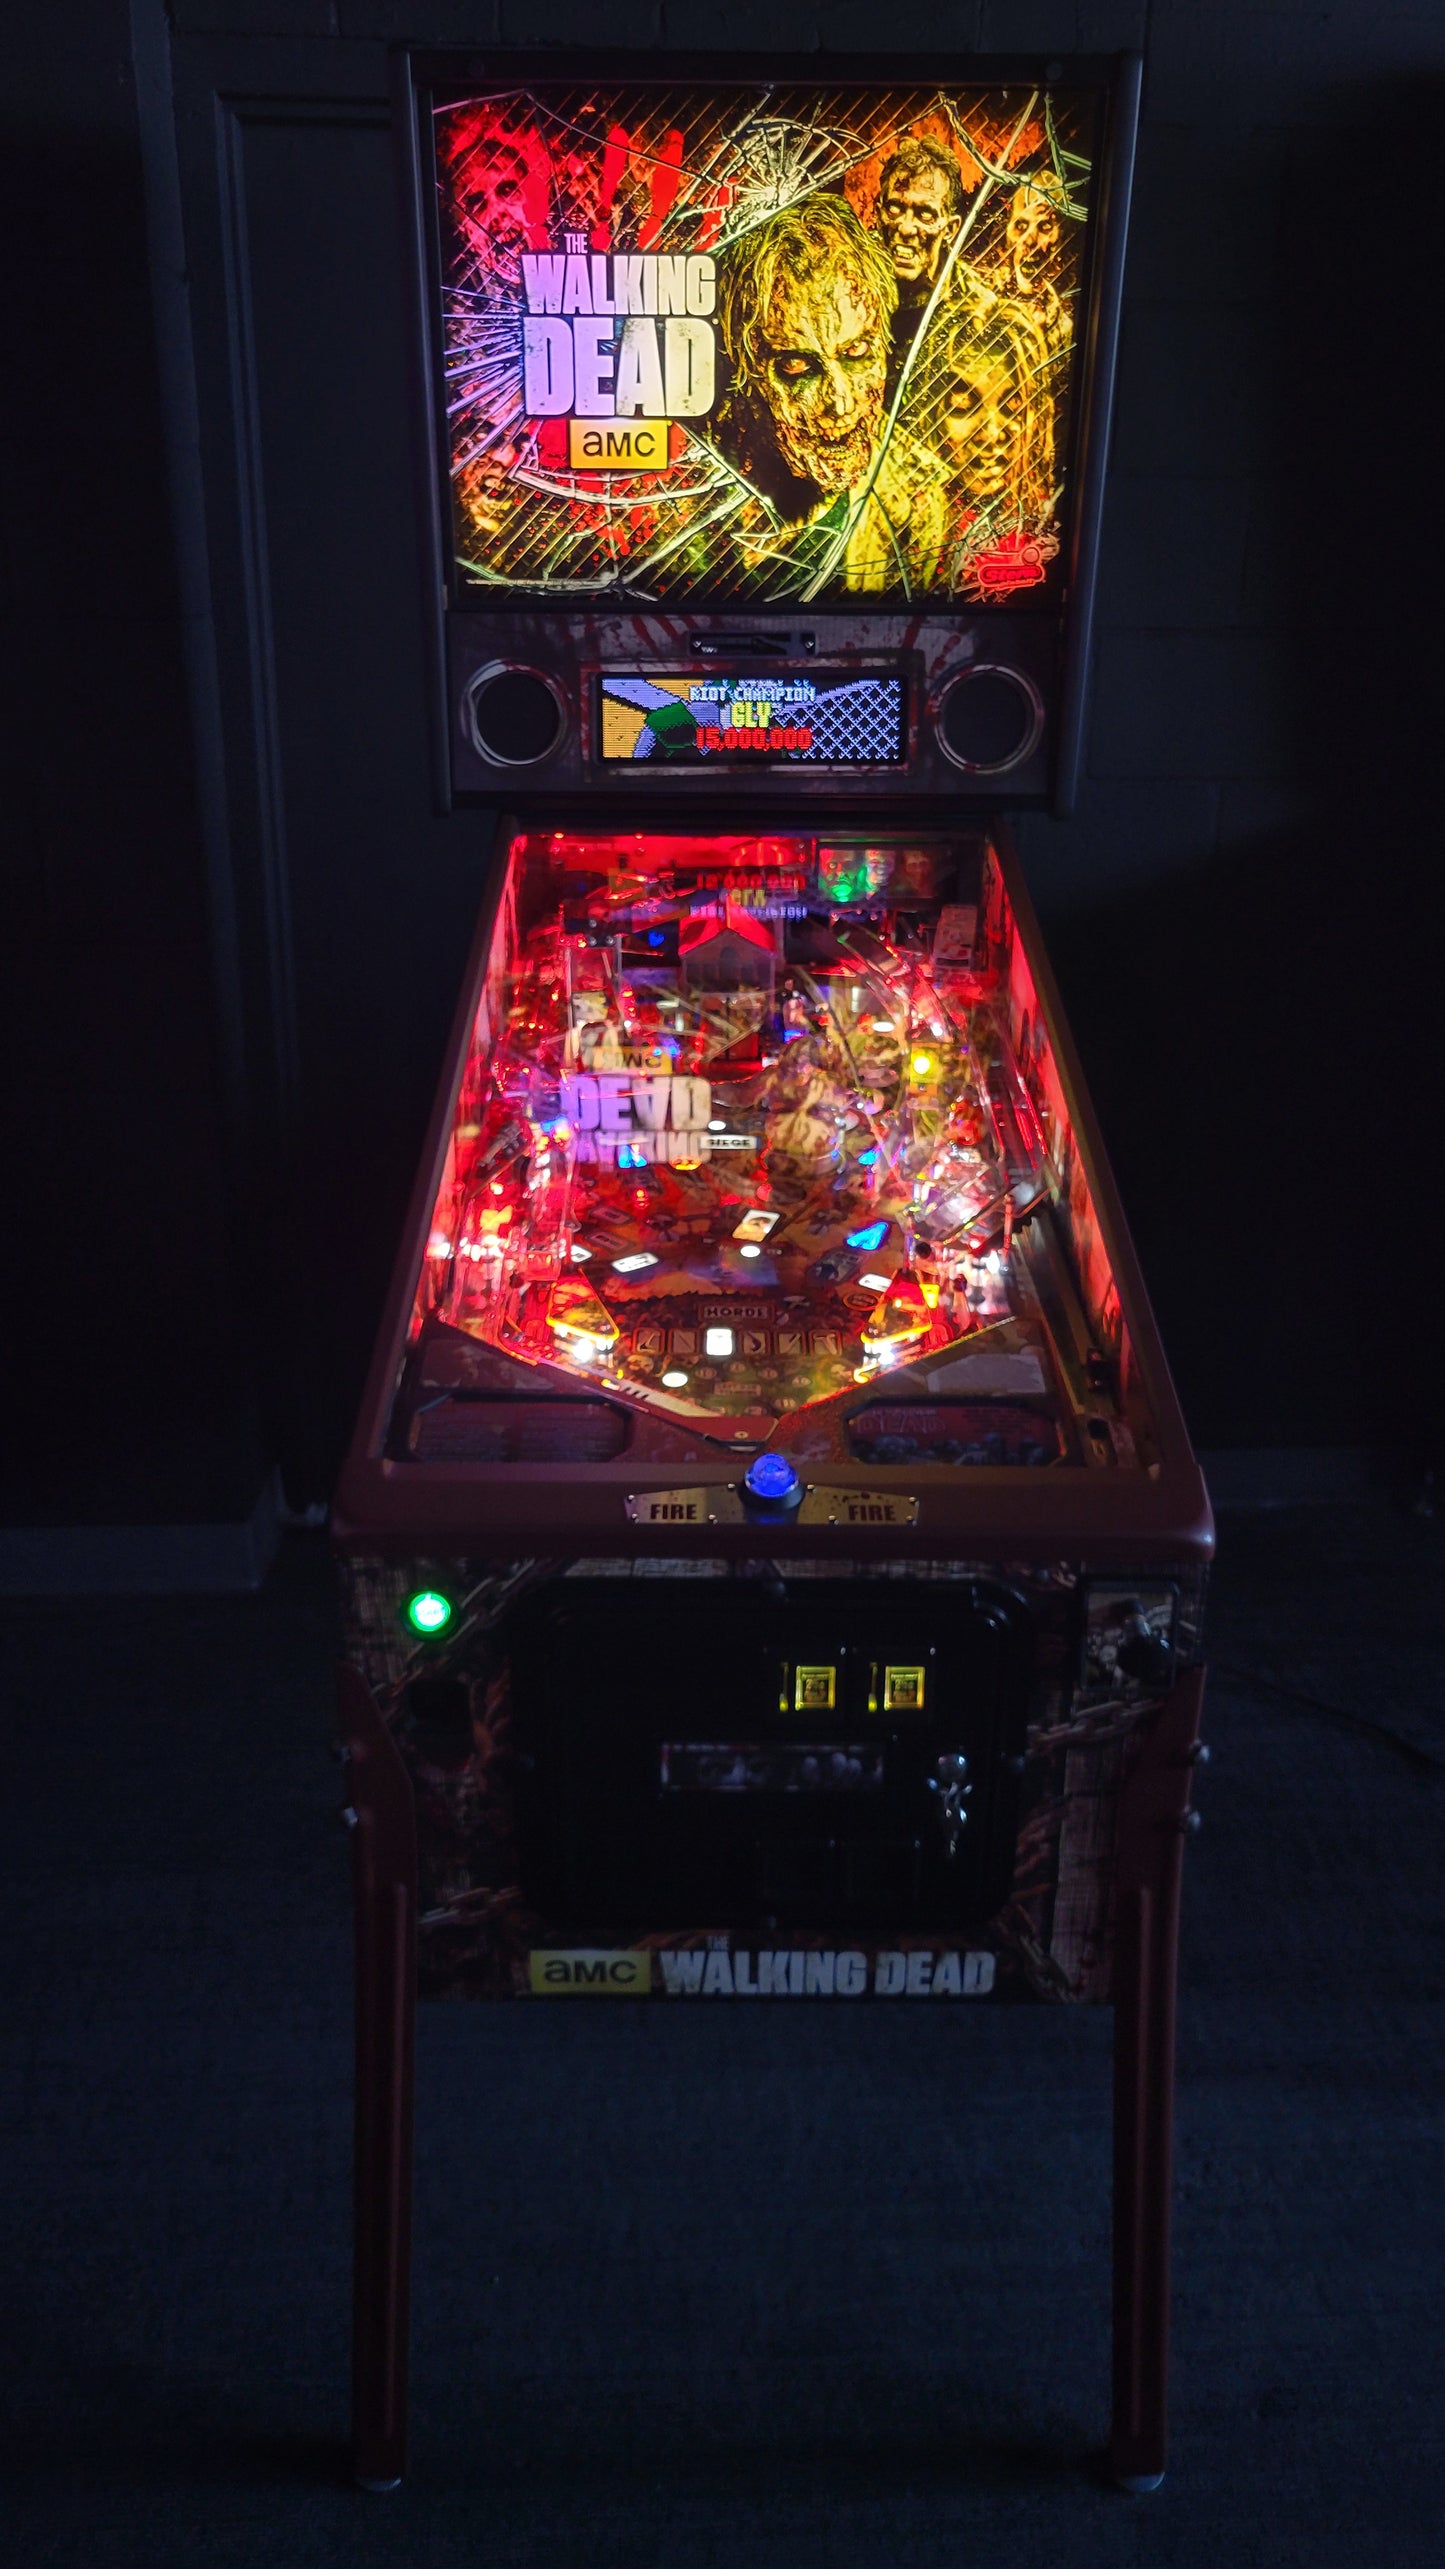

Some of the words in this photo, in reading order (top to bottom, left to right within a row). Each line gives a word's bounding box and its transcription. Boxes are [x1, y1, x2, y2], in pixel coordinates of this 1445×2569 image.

[564, 233, 588, 254] THE
[521, 254, 716, 316] WALKING
[522, 317, 716, 417] DEAD
[690, 686, 728, 701] RIOT
[733, 686, 816, 701] CHAMPION
[696, 726, 813, 752] 15,000,000
[706, 1138, 751, 1147] SIEGE
[706, 1306, 765, 1319] HORDE
[650, 1503, 697, 1520] FIRE
[850, 1504, 896, 1522] FIRE
[708, 1935, 730, 1951] THE
[660, 1951, 868, 1995] WALKING
[873, 1951, 997, 1996] DEAD
